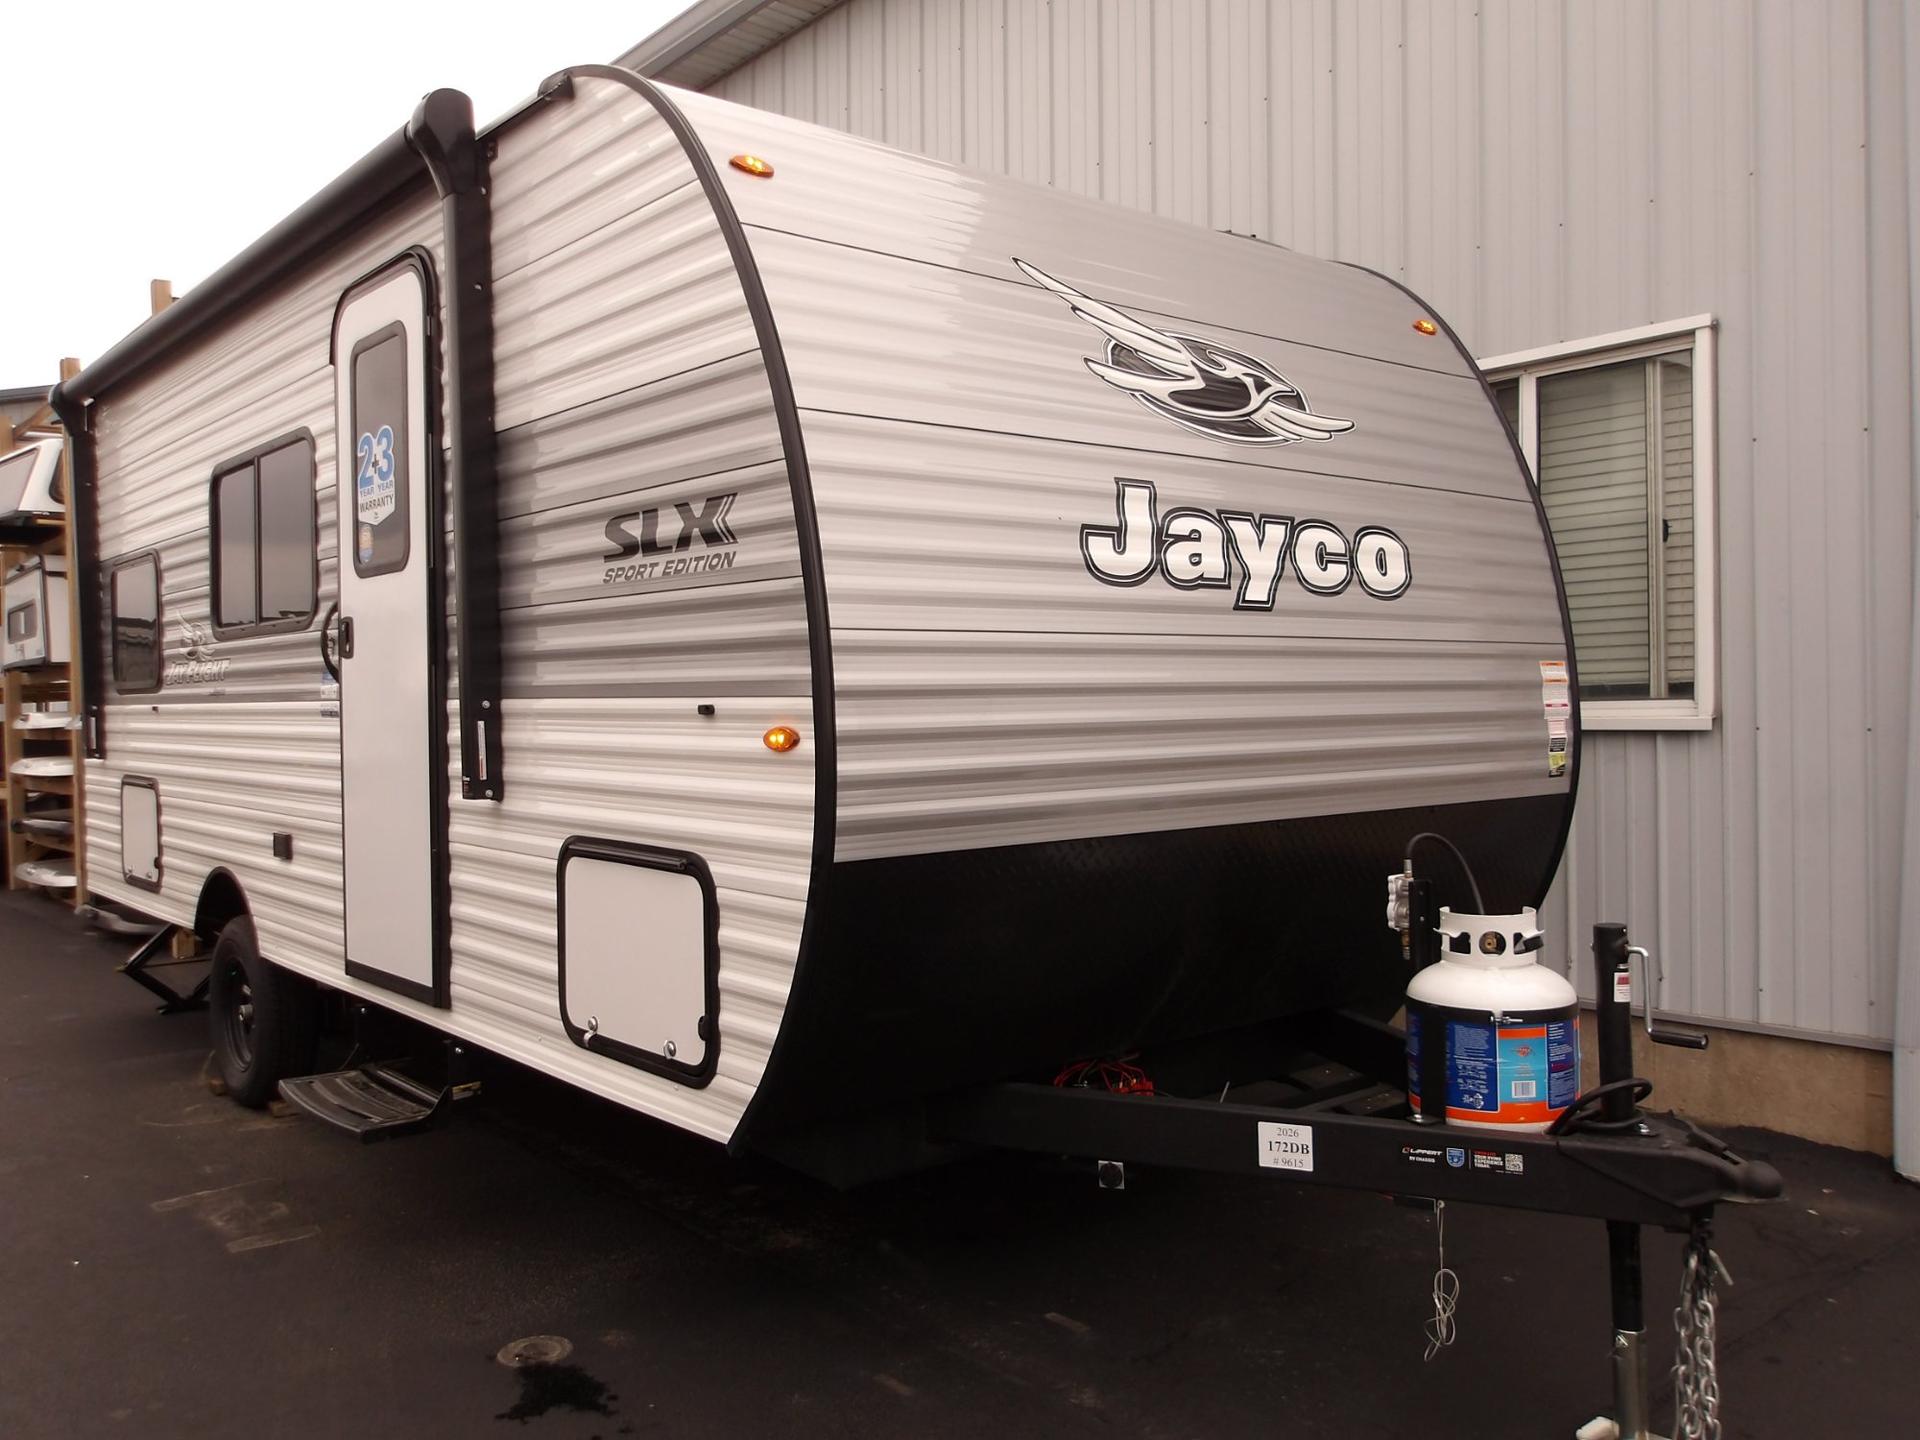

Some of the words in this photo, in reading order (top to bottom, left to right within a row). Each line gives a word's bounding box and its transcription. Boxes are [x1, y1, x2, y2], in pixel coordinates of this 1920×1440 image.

[360, 486, 375, 498] YEAR
[377, 480, 394, 493] YEAR
[359, 494, 394, 513] WARRANTY
[604, 492, 739, 563] SLX
[1079, 477, 1412, 611] Jayco
[602, 562, 659, 584] SPORT
[661, 551, 737, 577] EDITION
[1276, 1127, 1299, 1138] 2026
[1268, 1140, 1310, 1155] 172DB
[1281, 1157, 1304, 1168] 9615
